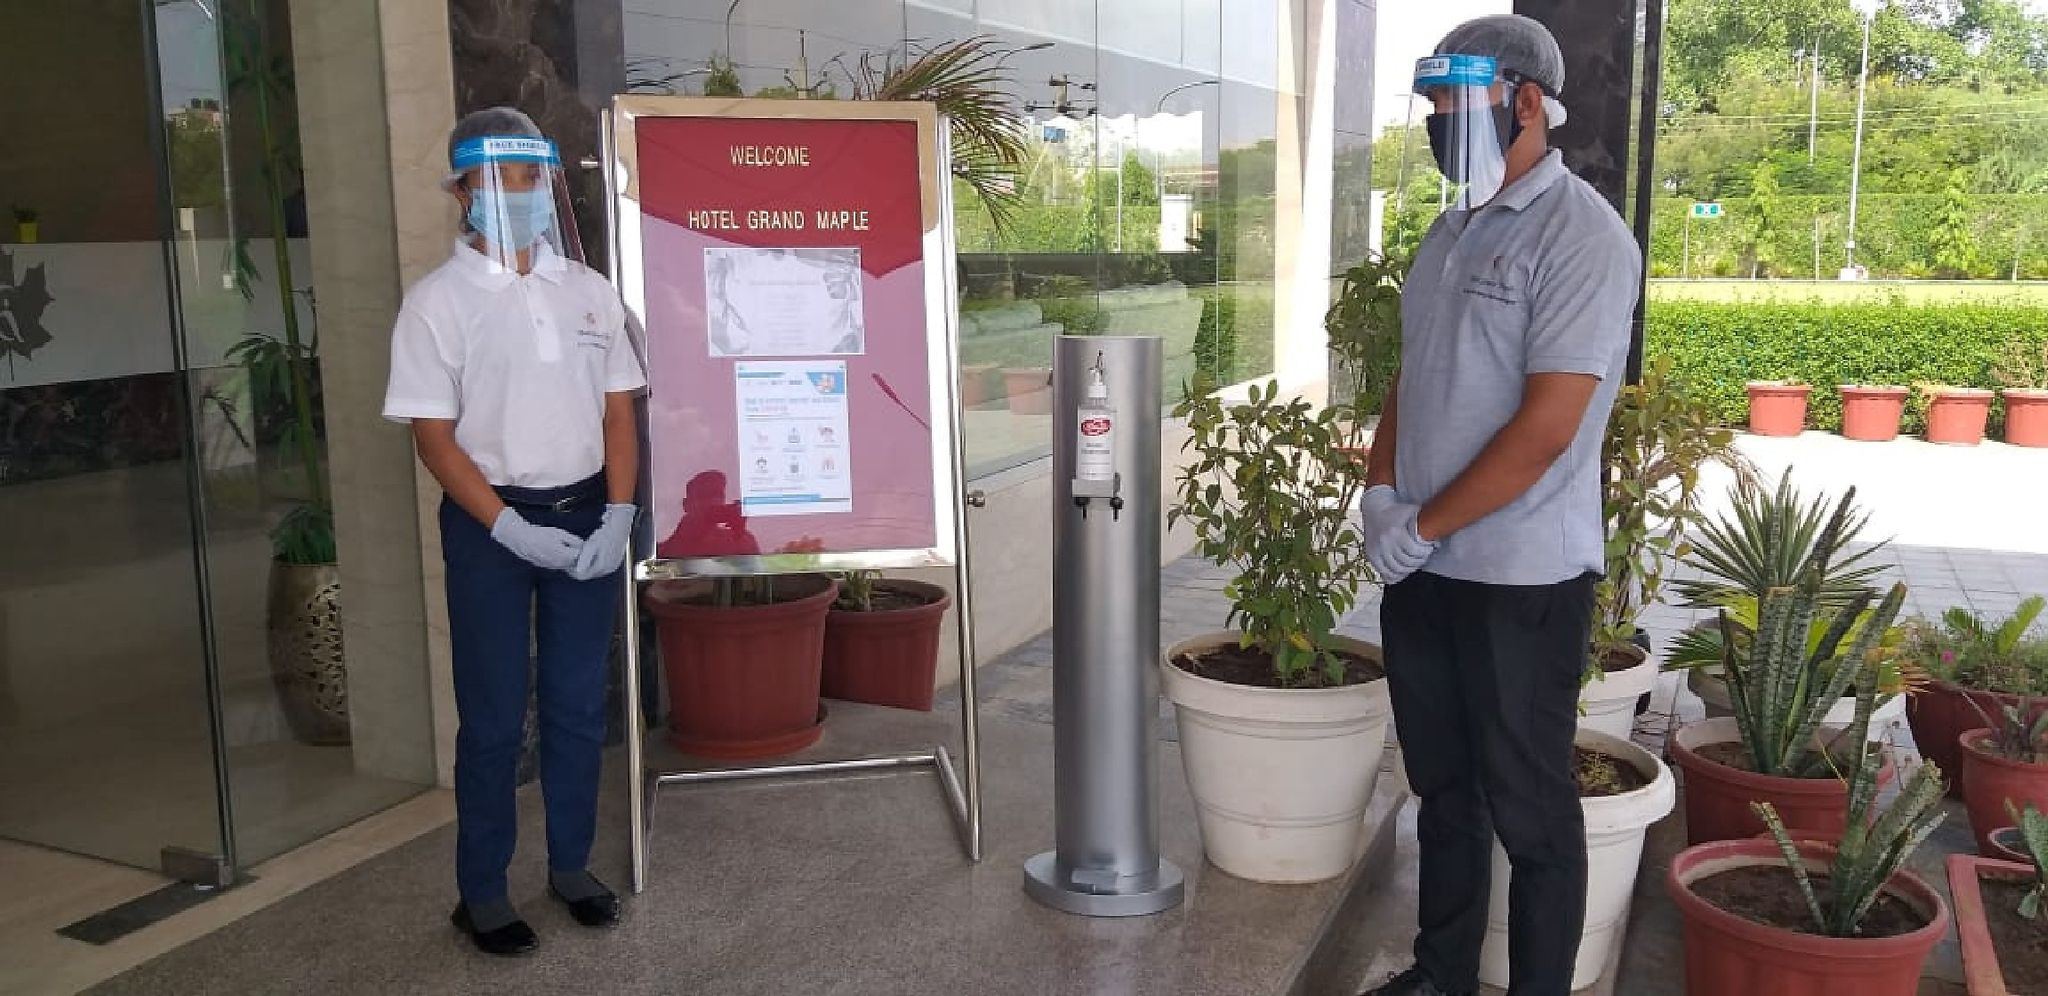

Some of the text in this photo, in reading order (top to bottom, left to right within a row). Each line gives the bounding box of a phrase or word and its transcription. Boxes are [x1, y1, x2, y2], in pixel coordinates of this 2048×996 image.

[730, 145, 810, 167] WELCOME
[689, 210, 869, 231] HOTEL GRAND MAPLE
